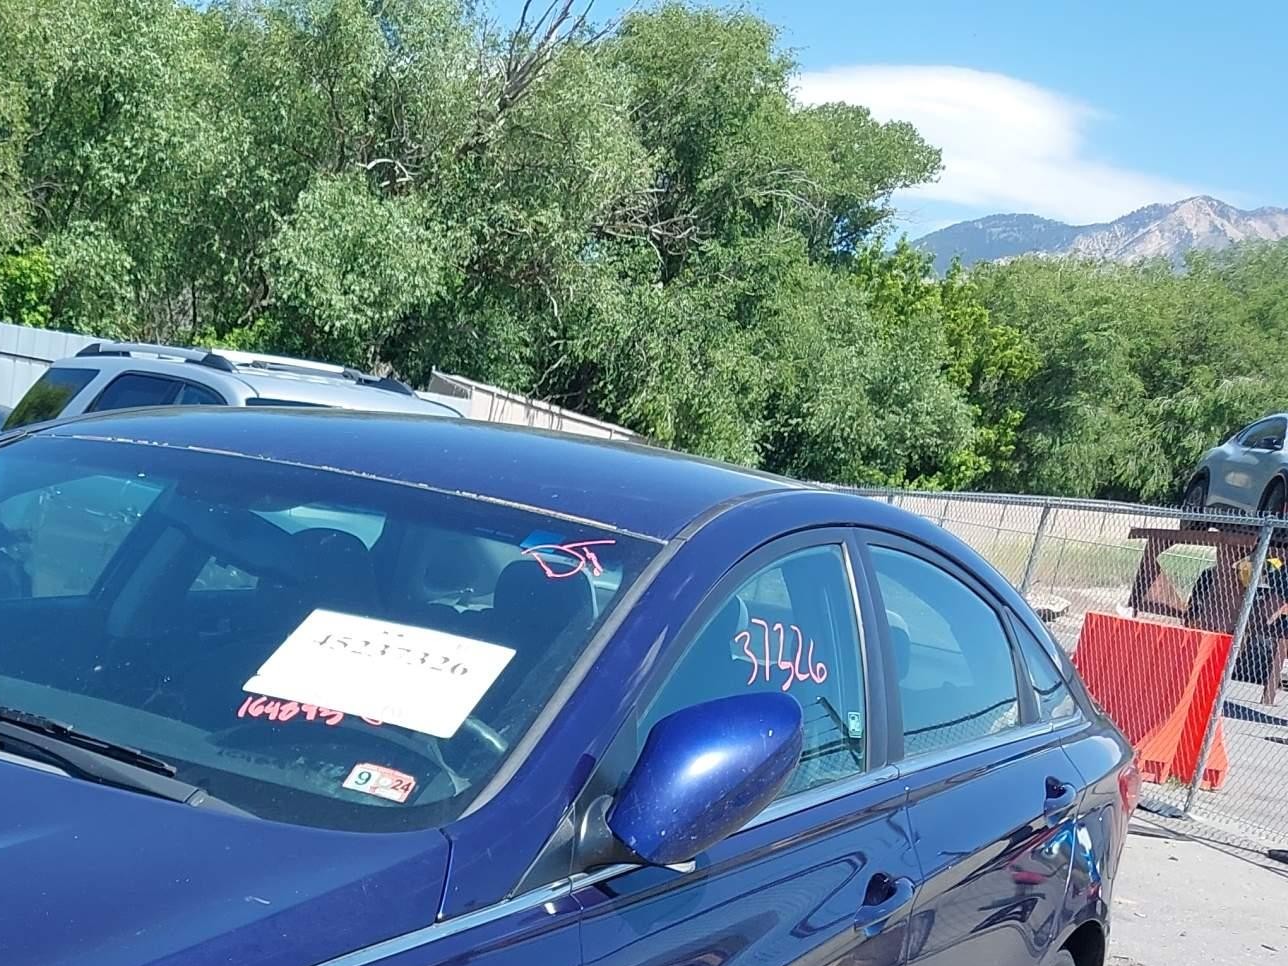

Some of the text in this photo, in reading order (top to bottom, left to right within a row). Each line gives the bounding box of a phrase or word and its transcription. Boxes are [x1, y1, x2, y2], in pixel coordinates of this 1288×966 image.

[734, 617, 828, 691] 37326
[354, 770, 413, 794] 9 24
